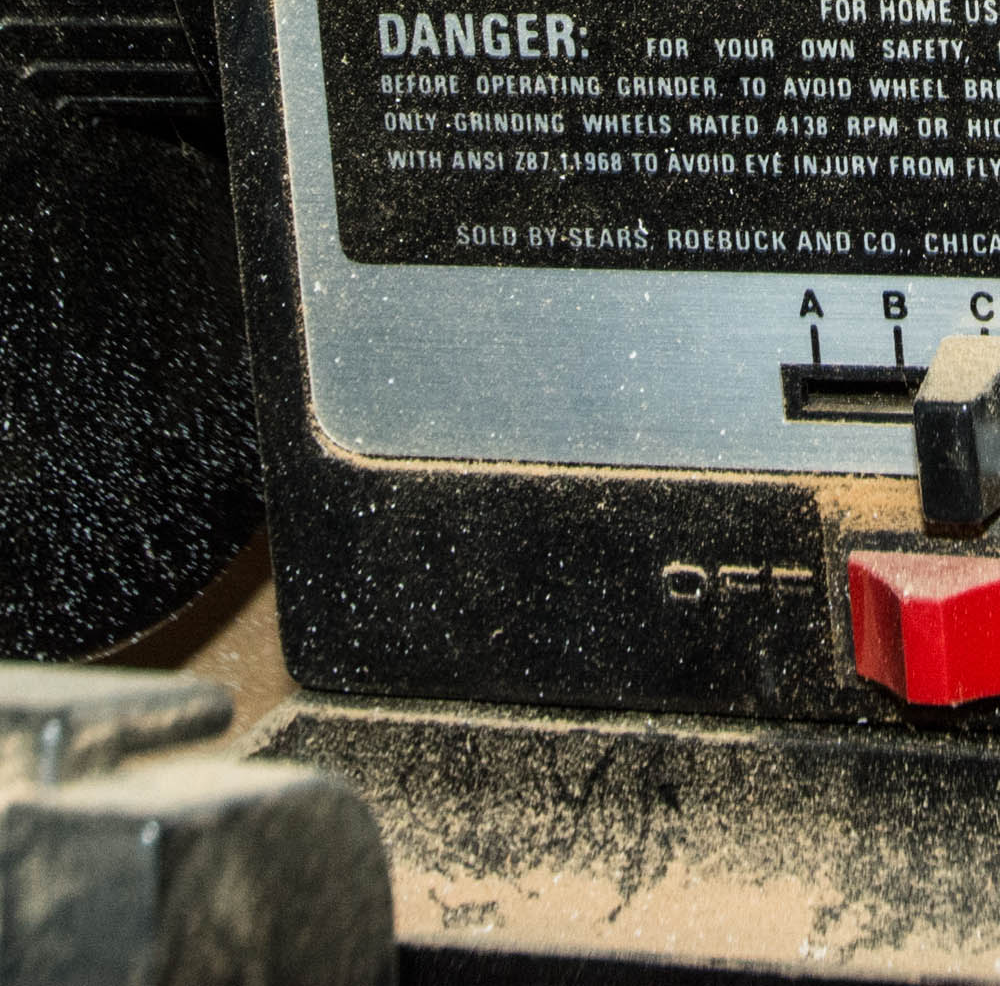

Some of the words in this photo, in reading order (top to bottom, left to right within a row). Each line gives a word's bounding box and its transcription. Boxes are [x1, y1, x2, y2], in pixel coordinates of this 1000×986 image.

[379, 13, 590, 59] DANGER:
[647, 38, 688, 60] FOR
[714, 38, 775, 60] YOUR
[801, 40, 855, 61] OWN
[381, 75, 460, 96] BEFORE
[477, 75, 600, 97] OPERATING
[740, 78, 766, 98] TO
[784, 78, 852, 100] AVOID
[869, 79, 949, 101] WHEEL
[385, 113, 436, 133] ONLY
[454, 113, 565, 134] GRINDING
[583, 115, 672, 135] WHEELS
[689, 115, 759, 136] RATED
[848, 117, 898, 138] RPM
[918, 117, 948, 139] OR
[388, 150, 442, 171] WITH
[452, 151, 503, 172] ANSI
[632, 153, 658, 174] TO
[668, 154, 735, 175] AVOID
[746, 154, 782, 176] EYE
[794, 156, 878, 177] INJURY
[889, 157, 955, 179] FROM
[457, 226, 517, 249] SOLD
[528, 227, 557, 249] BY
[667, 229, 786, 253] ROEBUCK
[798, 230, 850, 254] AND
[799, 289, 824, 319] A
[882, 291, 908, 320] B
[969, 291, 995, 322] C
